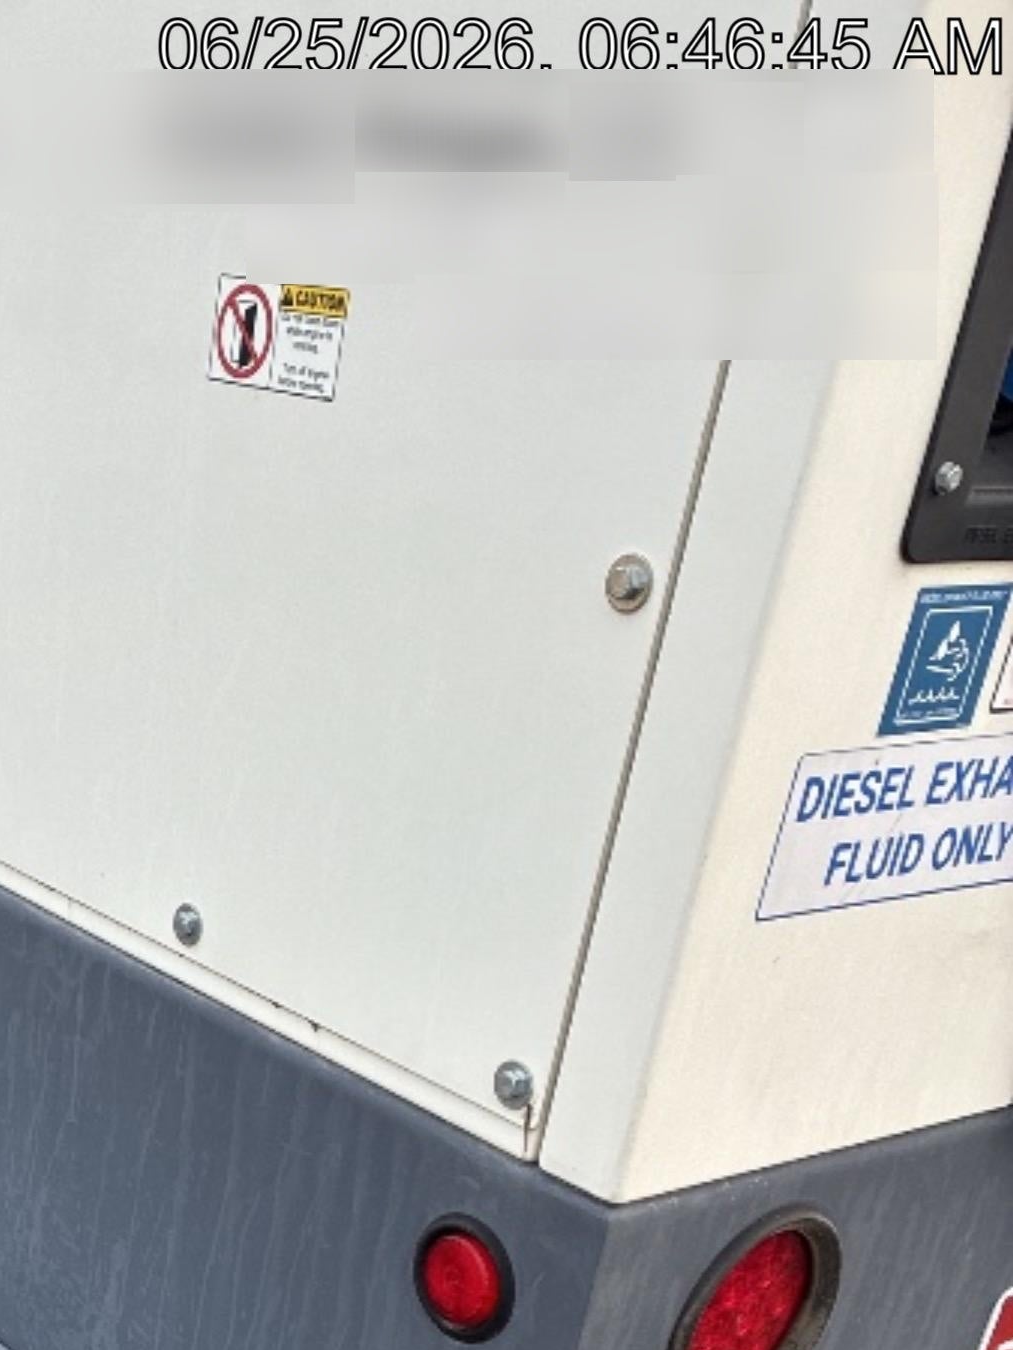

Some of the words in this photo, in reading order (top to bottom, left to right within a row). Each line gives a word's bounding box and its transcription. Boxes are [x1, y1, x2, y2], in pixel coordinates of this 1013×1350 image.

[796, 766, 915, 823] DIESEL
[824, 832, 925, 887] FLUID
[931, 820, 1013, 871] ONLY
